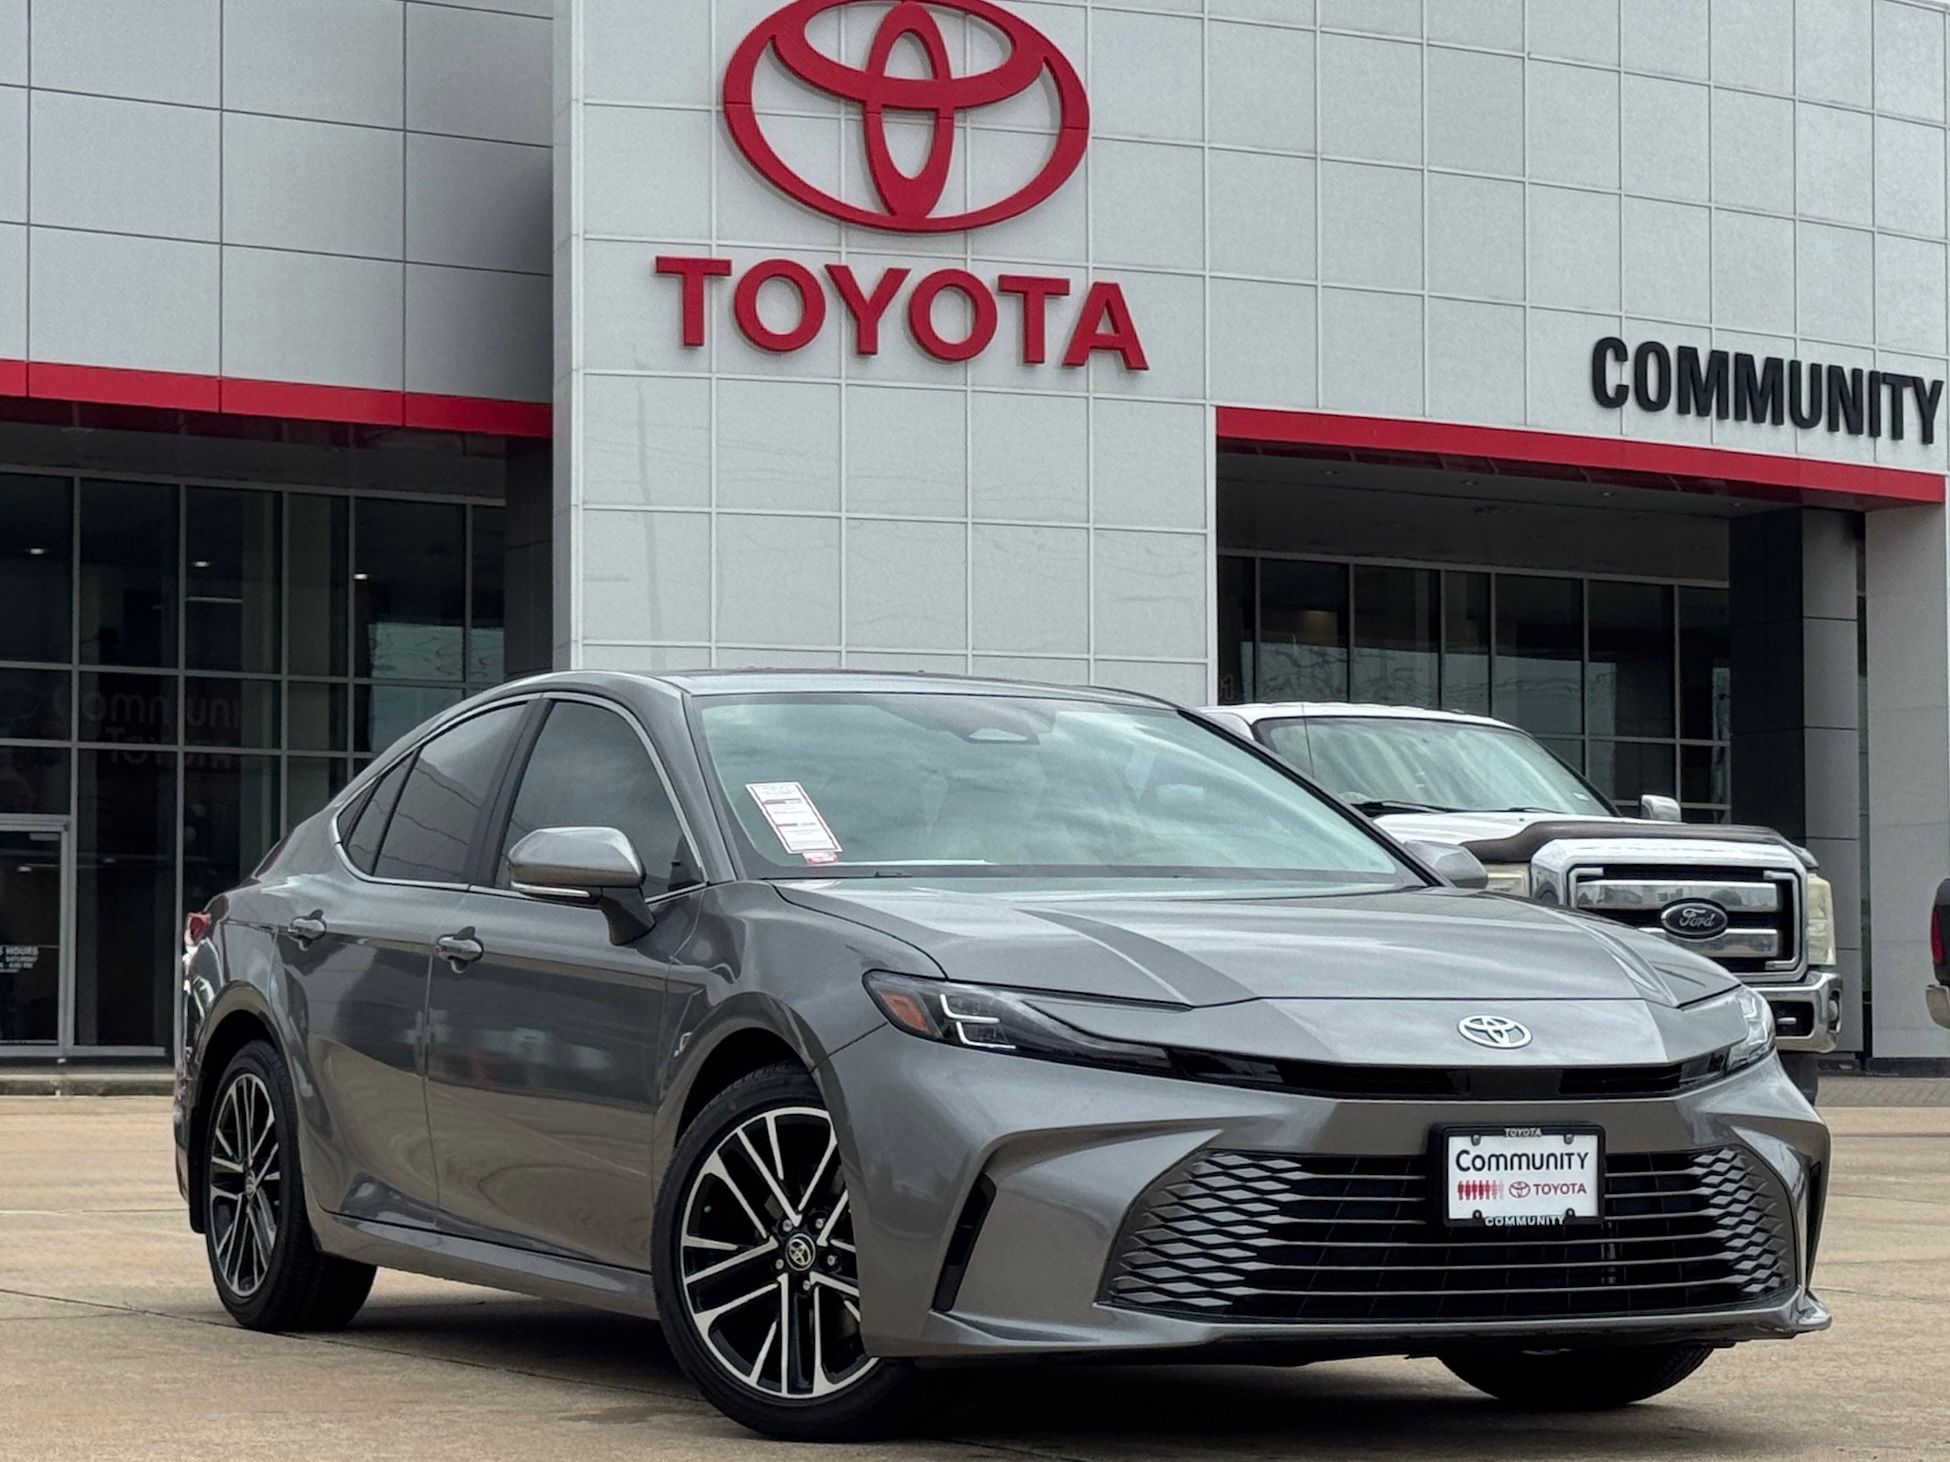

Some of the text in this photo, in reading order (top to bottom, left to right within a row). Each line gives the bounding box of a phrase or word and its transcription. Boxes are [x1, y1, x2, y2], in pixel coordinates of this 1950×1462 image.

[655, 255, 1149, 370] TOYOTA
[1592, 336, 1944, 446] COMMUNITY
[1679, 908, 1716, 928] Ford
[1504, 1128, 1542, 1138] TOYOTA
[1533, 1182, 1587, 1196] TOYOTA
[1485, 1216, 1565, 1227] COMMUNITY
